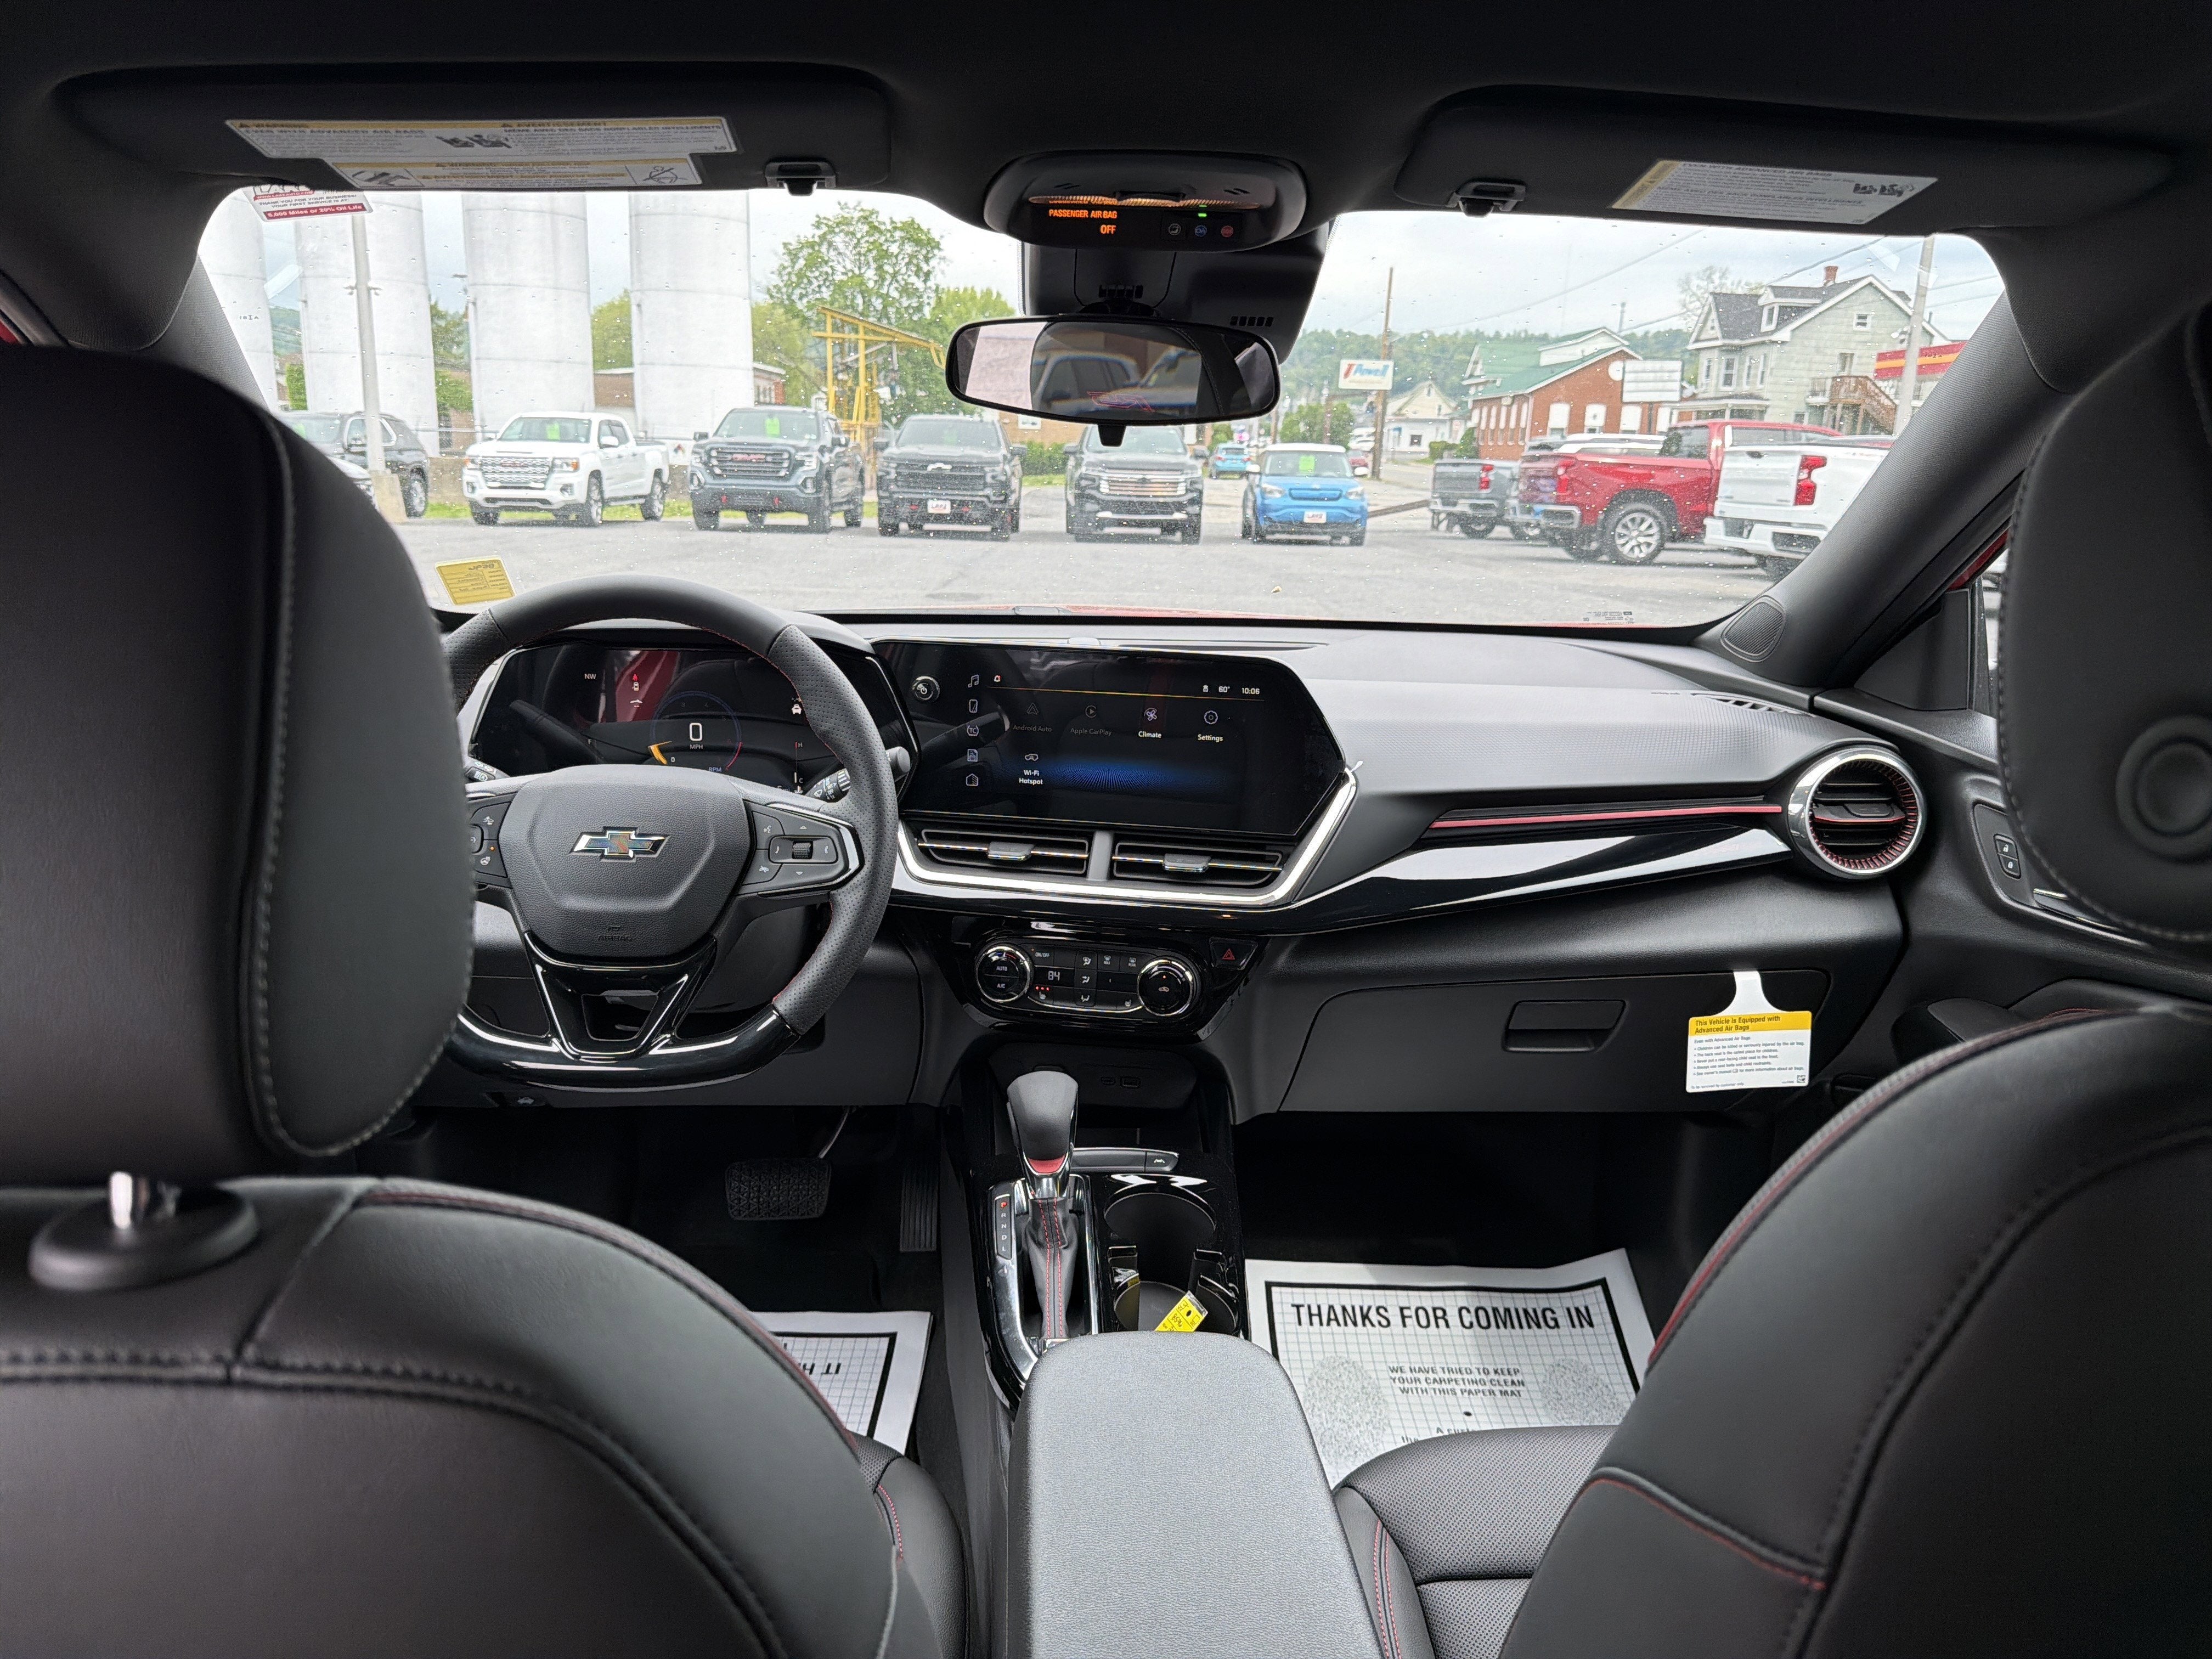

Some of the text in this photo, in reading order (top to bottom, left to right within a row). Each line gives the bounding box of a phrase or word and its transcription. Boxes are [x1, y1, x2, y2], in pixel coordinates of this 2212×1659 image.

[1048, 209, 1118, 219] PASSENGER AIR BAG
[1100, 224, 1116, 234] OFF
[690, 723, 702, 741] 0
[1089, 728, 1112, 737] CarPlay
[1198, 734, 1223, 742] Settings
[1019, 777, 1043, 786] Hotspot
[1048, 970, 1060, 981] 84
[1695, 1026, 1723, 1034] Advanced
[1291, 1304, 1595, 1330] THANKS FOR COMING IN
[1388, 1365, 1520, 1376] WE HAVE TRIED TO KEEP
[1390, 1375, 1525, 1387] YOUR CARPETING CLEAN
[1399, 1386, 1522, 1397] WITH THIS PAPER MAT
